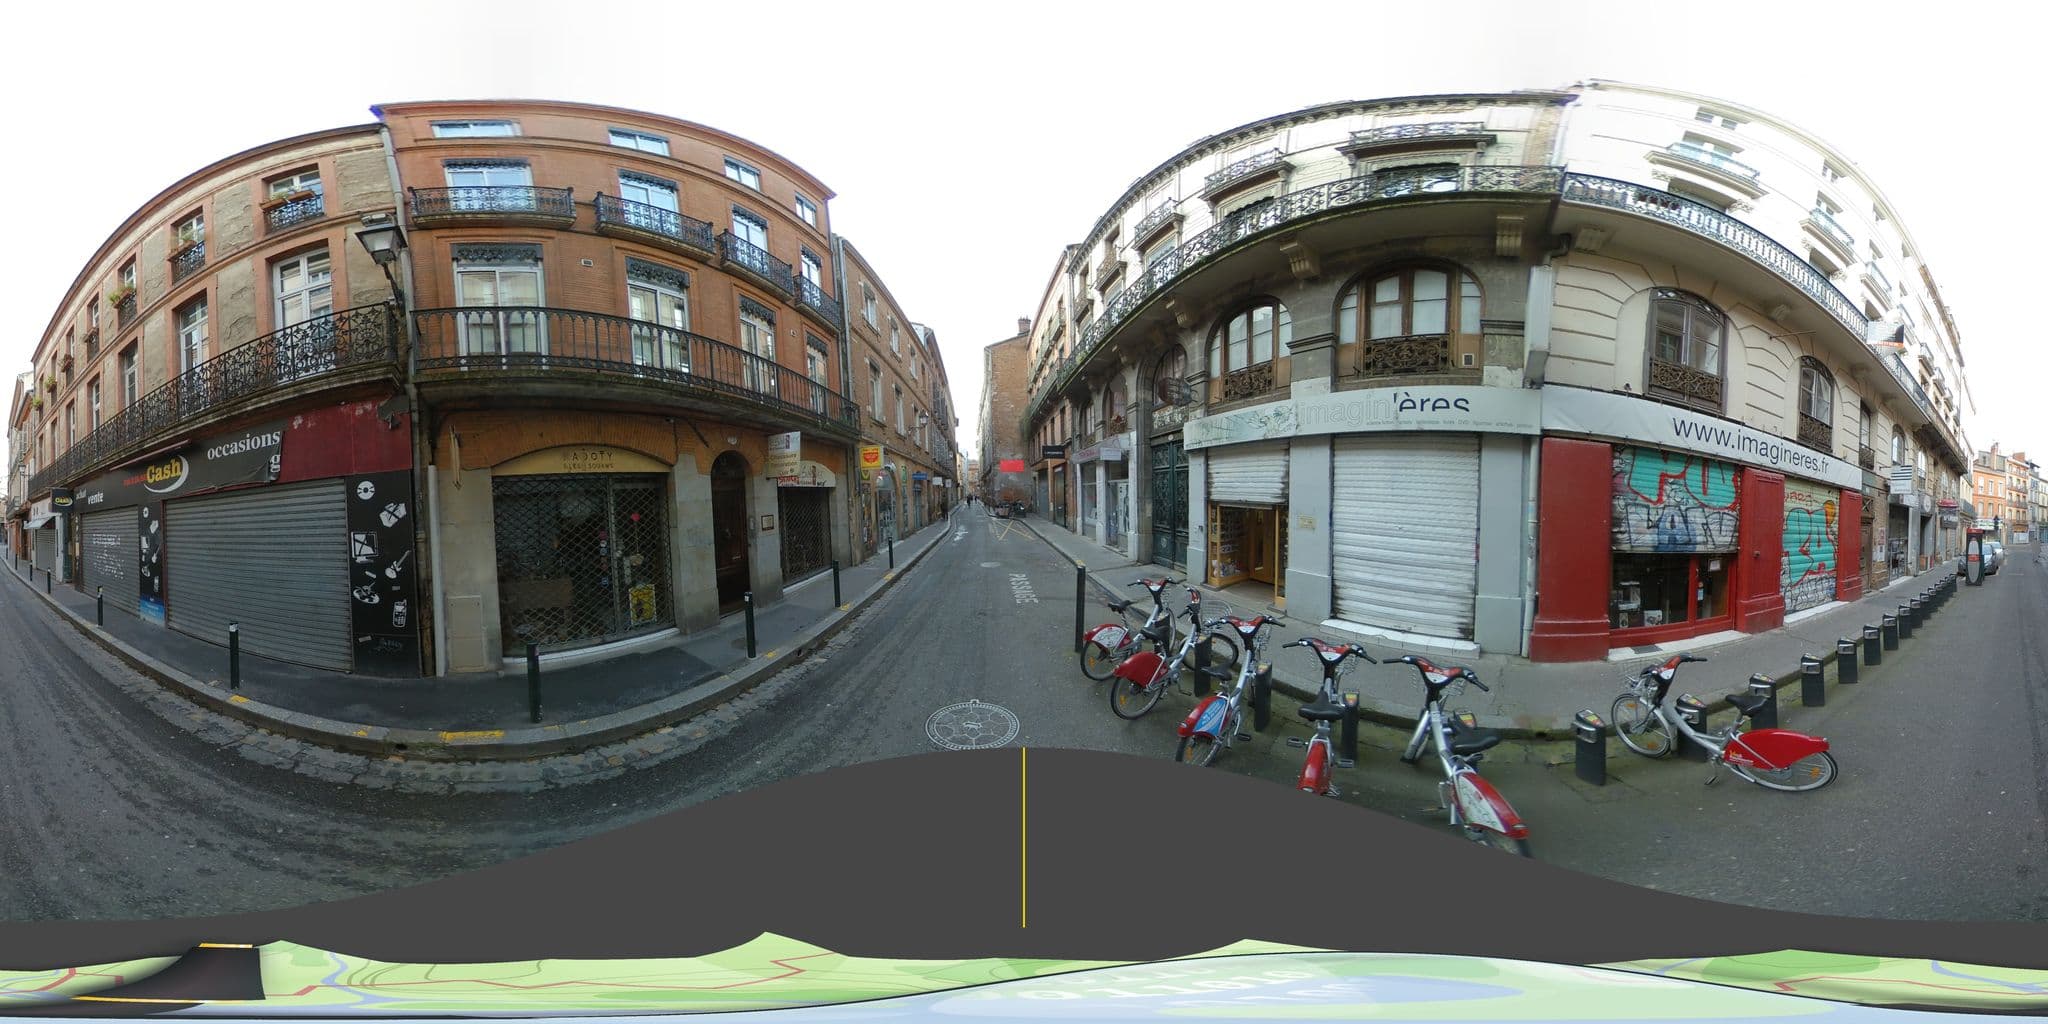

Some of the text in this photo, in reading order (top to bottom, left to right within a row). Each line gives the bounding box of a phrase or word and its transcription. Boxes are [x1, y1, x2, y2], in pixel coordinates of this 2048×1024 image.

[207, 430, 281, 460] occasions
[1673, 417, 1829, 474] www.imagineres.fr
[146, 459, 182, 484] Cash
[88, 492, 104, 505] vente
[1009, 573, 1039, 603] PASSAGE
